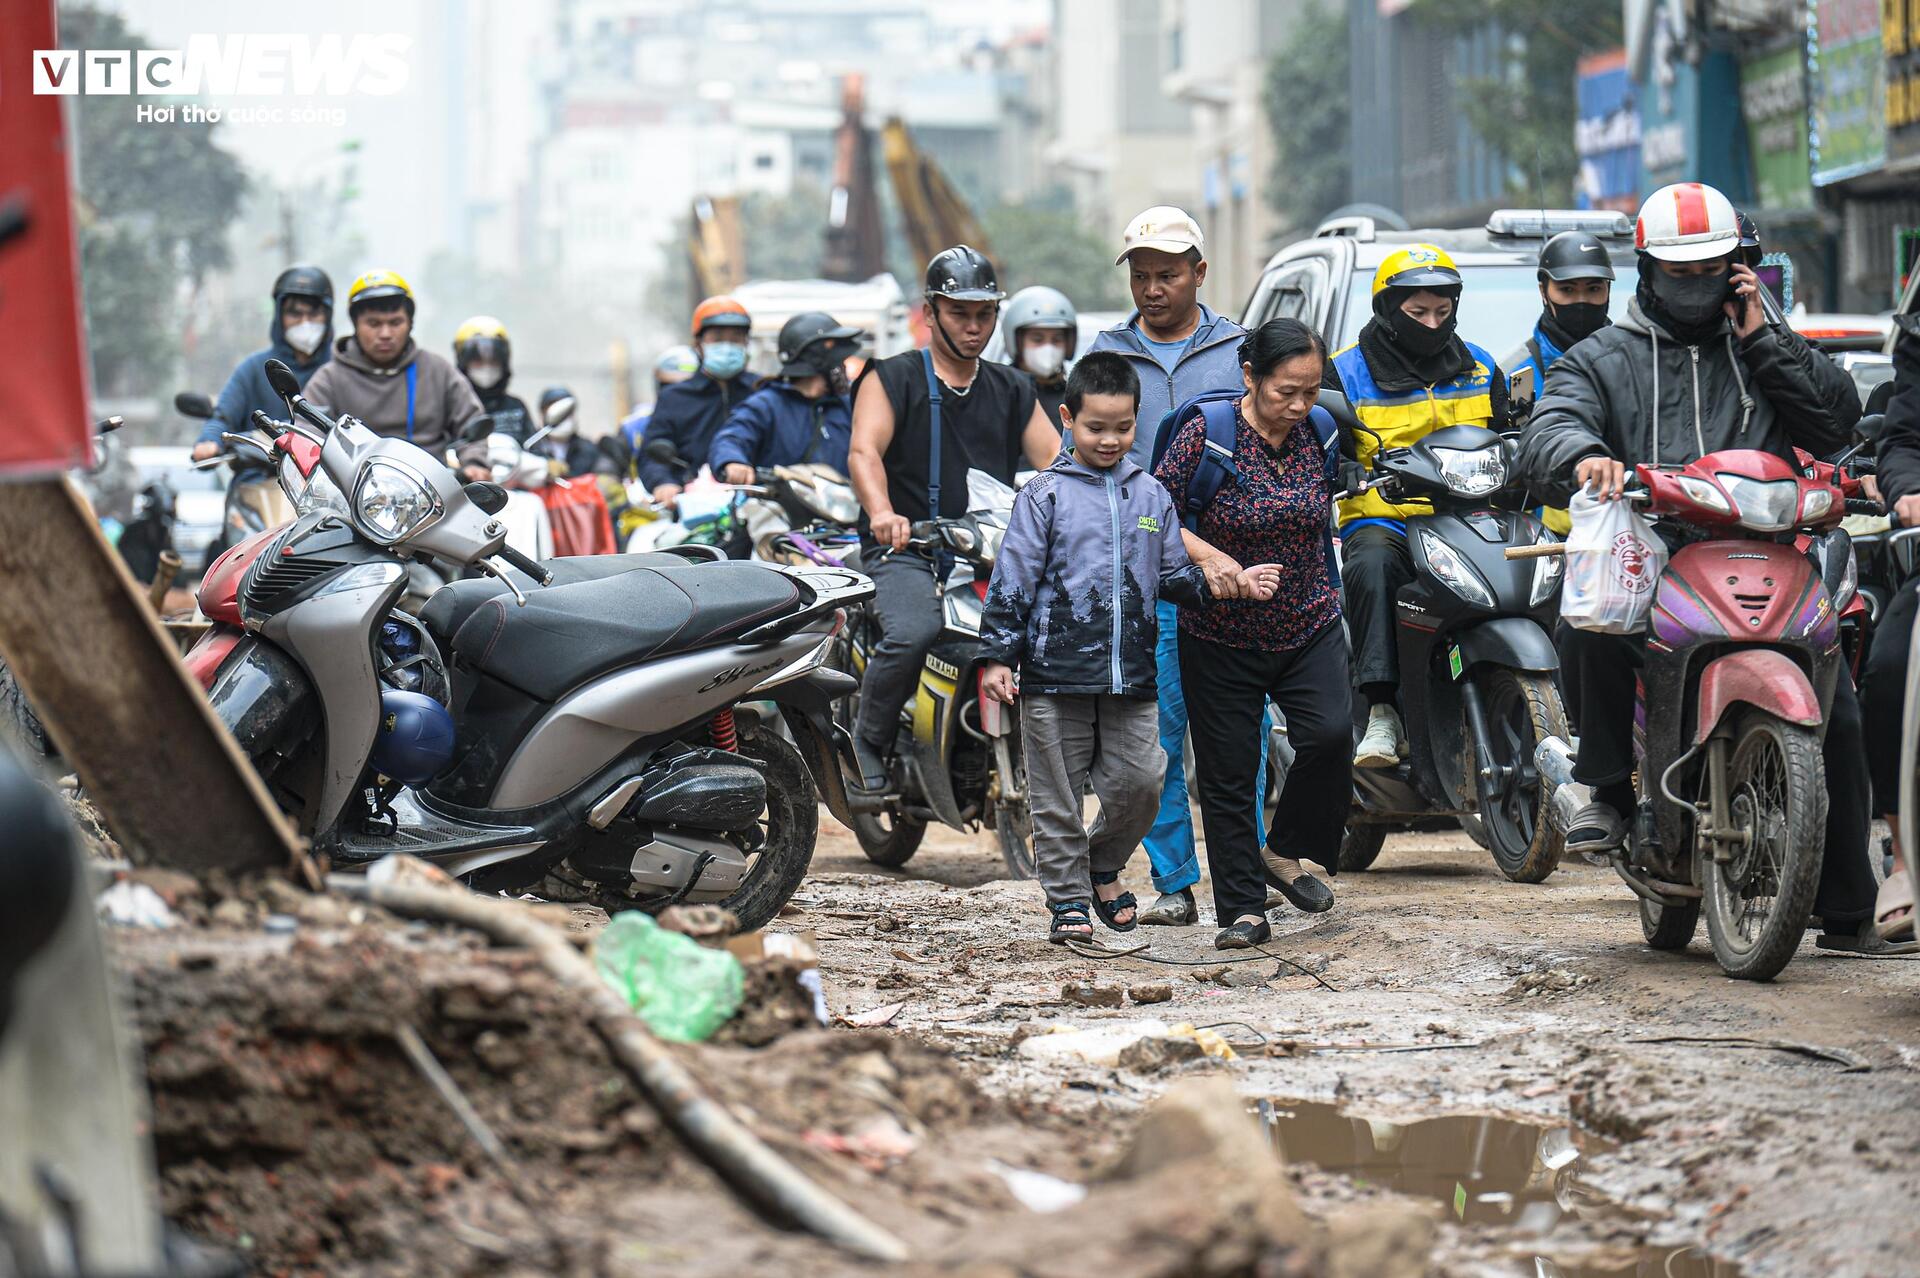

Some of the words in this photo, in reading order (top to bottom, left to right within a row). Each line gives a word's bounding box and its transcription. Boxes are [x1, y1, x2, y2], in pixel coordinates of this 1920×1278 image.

[1397, 600, 1427, 613] SPORT
[698, 662, 750, 694] SH
[926, 653, 959, 680] YAMAHA
